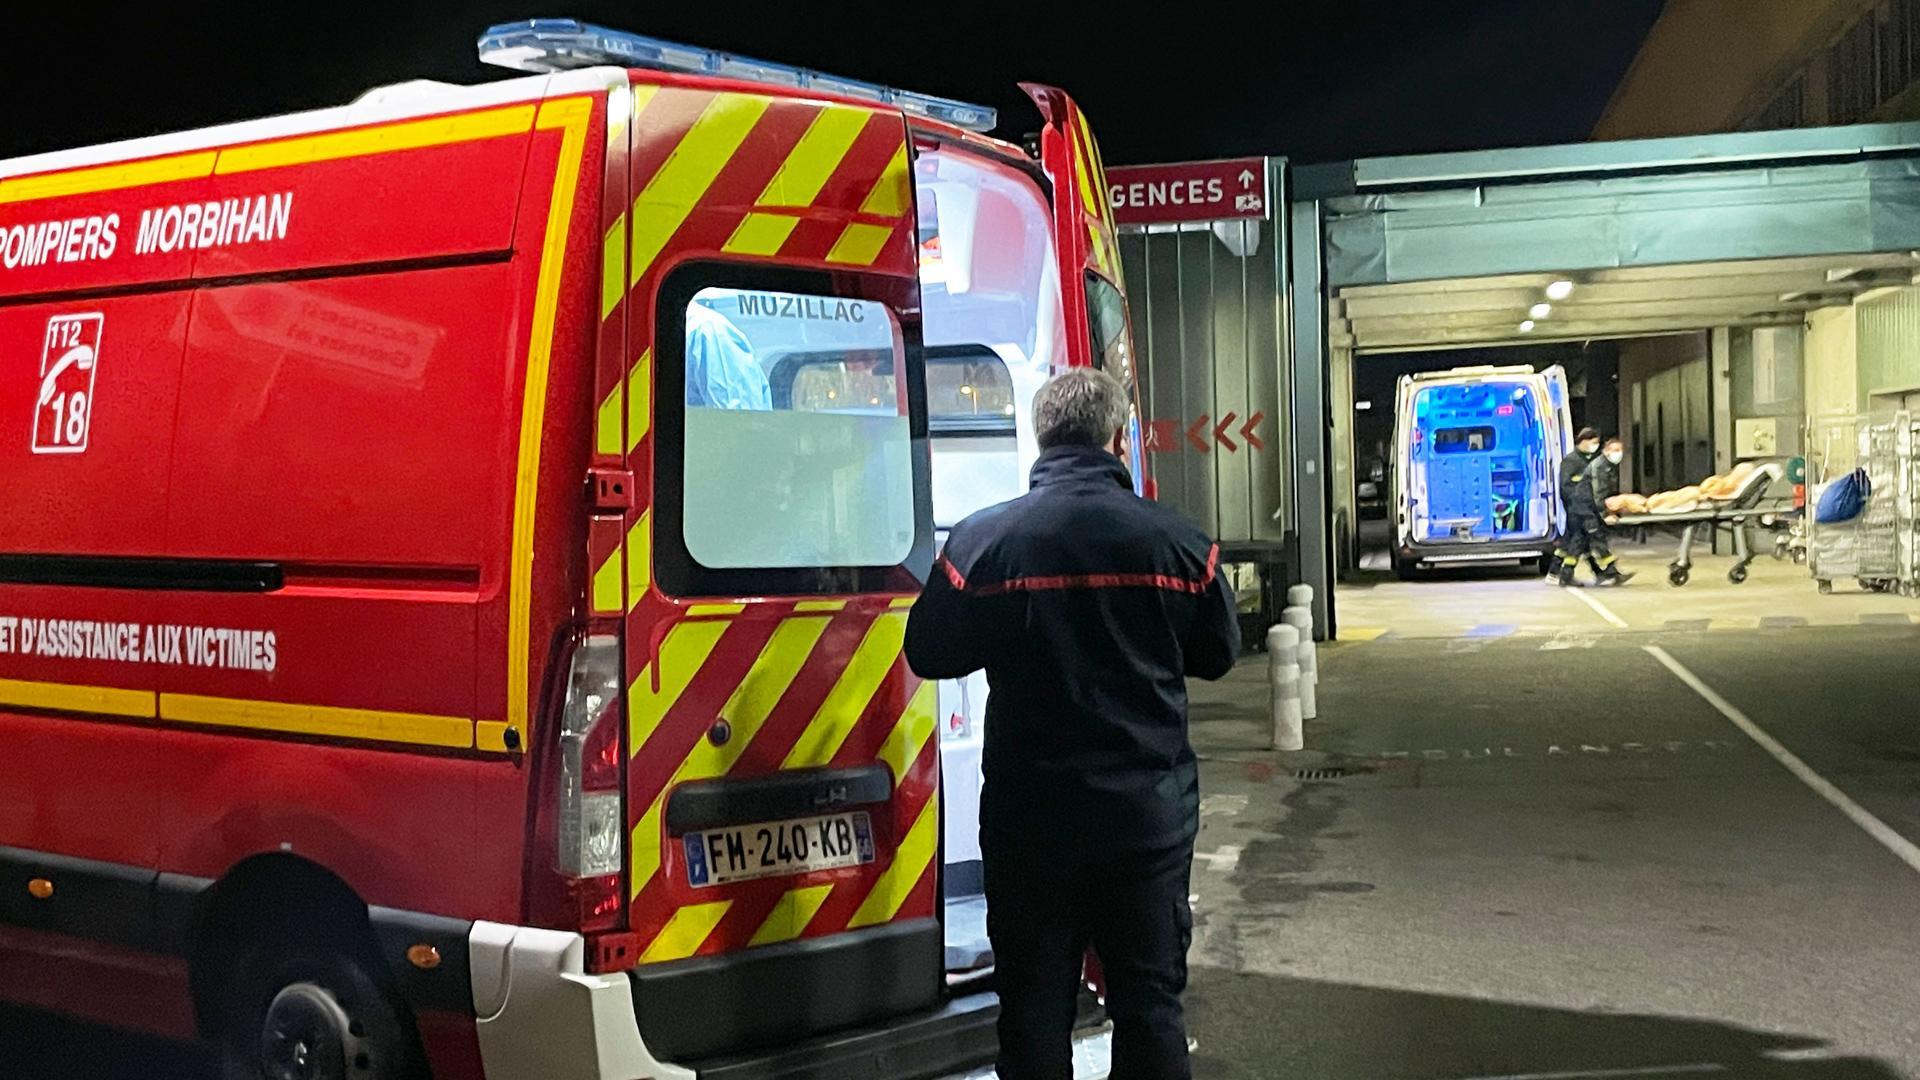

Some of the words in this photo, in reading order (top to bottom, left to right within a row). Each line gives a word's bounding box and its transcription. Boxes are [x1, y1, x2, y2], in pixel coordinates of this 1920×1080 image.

[1110, 178, 1223, 208] GENCES
[135, 192, 293, 255] MORBIHAN
[738, 294, 864, 323] MUZILLAC
[51, 321, 82, 348] 112
[52, 391, 86, 444] 18
[0, 616, 18, 653] ET
[21, 618, 140, 662] D'ASSISTANCE
[144, 624, 182, 664] AUX
[186, 627, 276, 672] VICTIMES
